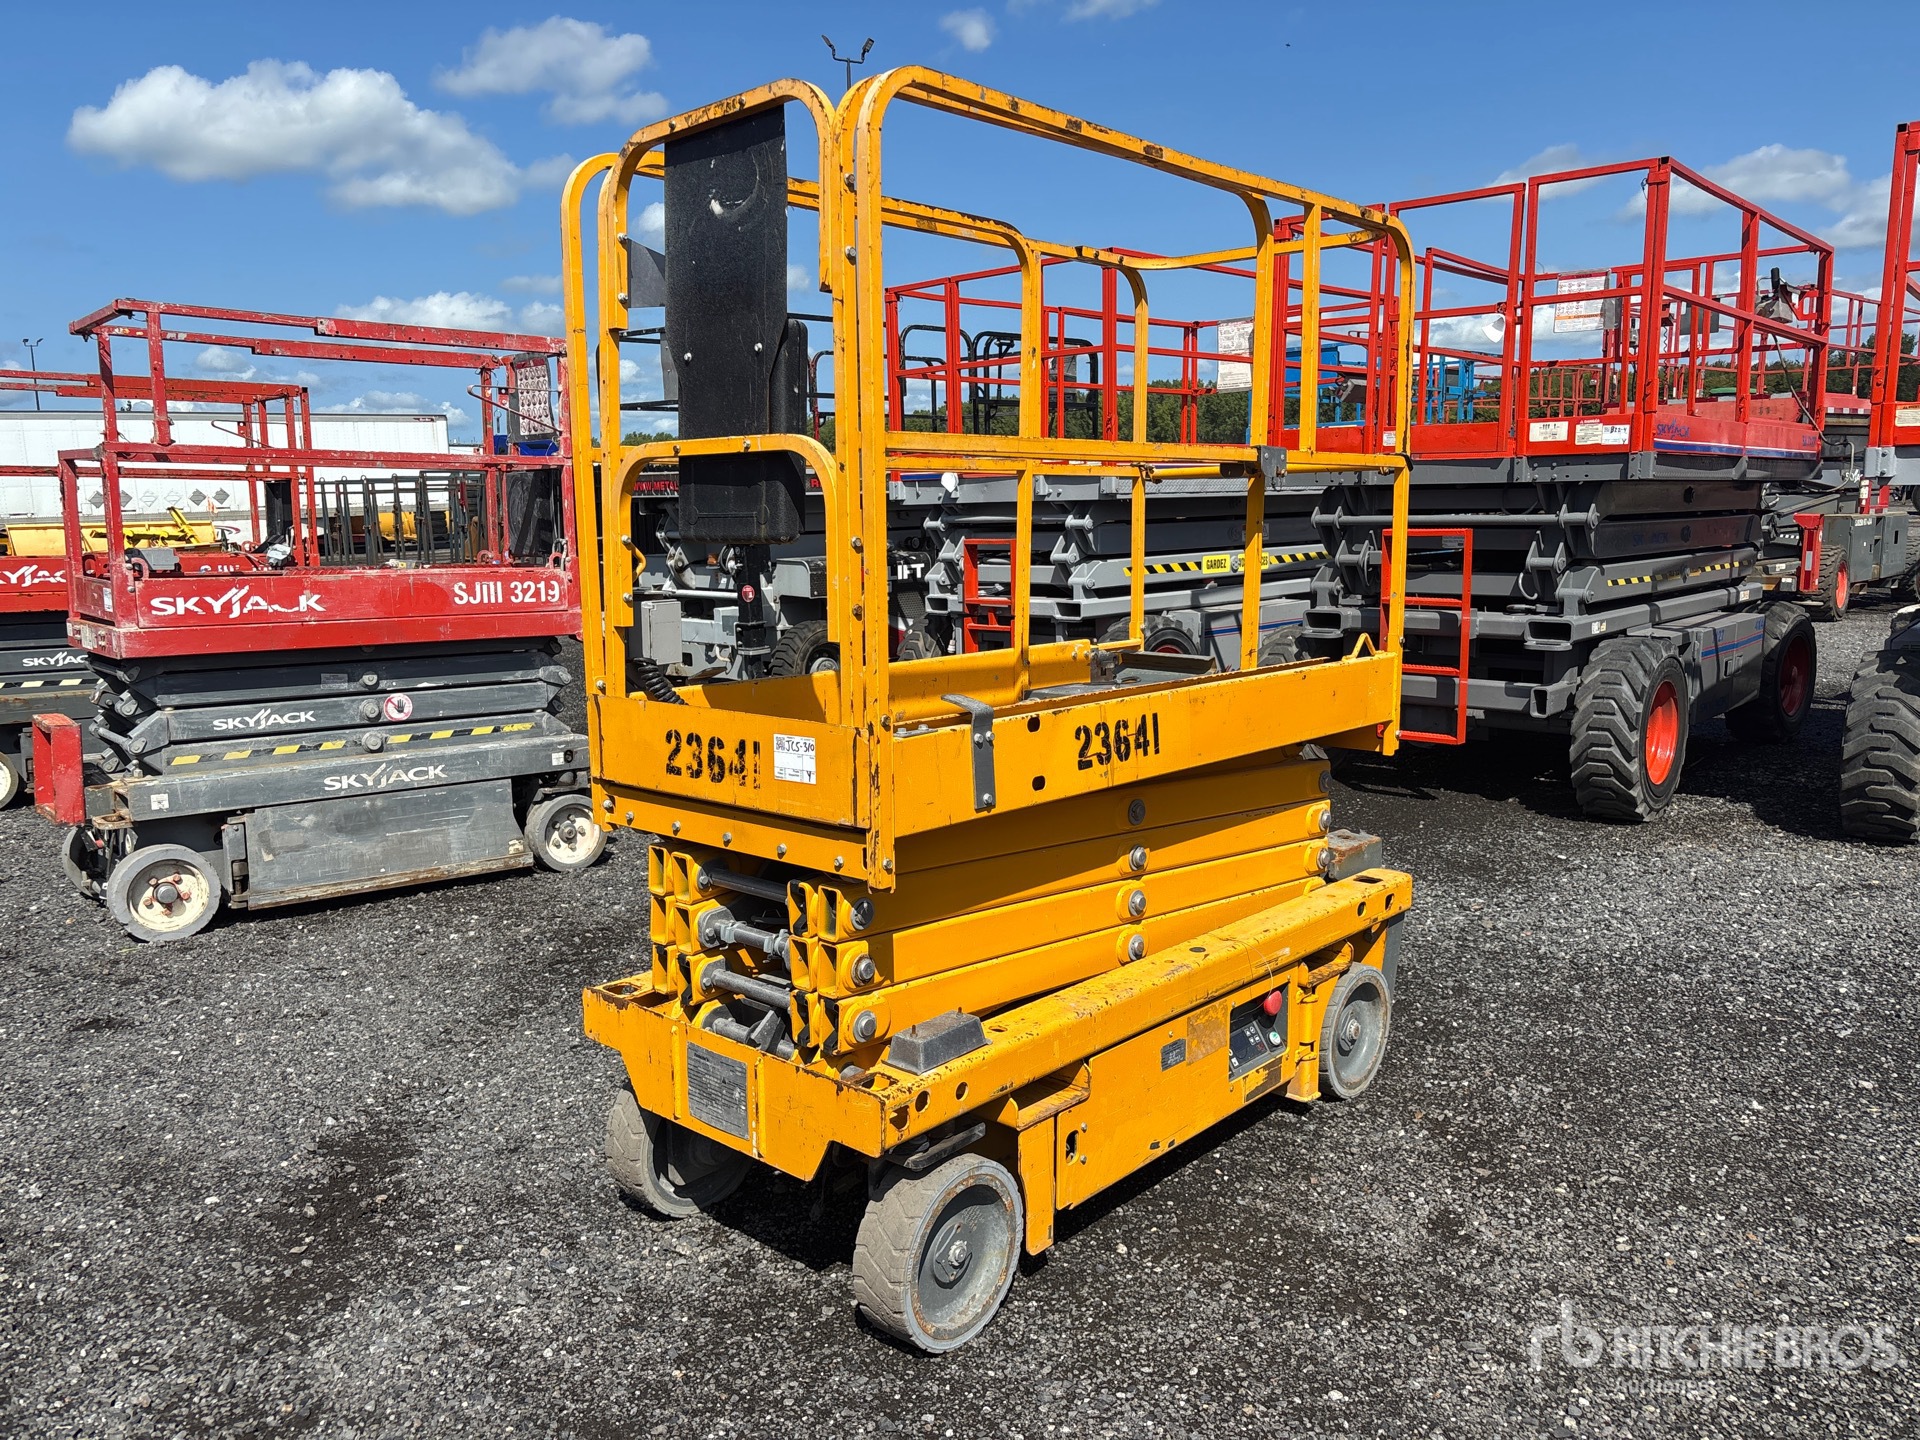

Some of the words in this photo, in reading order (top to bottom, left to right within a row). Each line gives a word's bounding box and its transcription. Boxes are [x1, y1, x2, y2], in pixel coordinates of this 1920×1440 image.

[1206, 558, 1227, 570] GARDEZ
[509, 580, 560, 603] 3219
[212, 708, 317, 731] SKYJACK
[1074, 712, 1160, 771] 23641
[665, 728, 761, 791] 23641
[323, 762, 449, 791] SKYJACK
